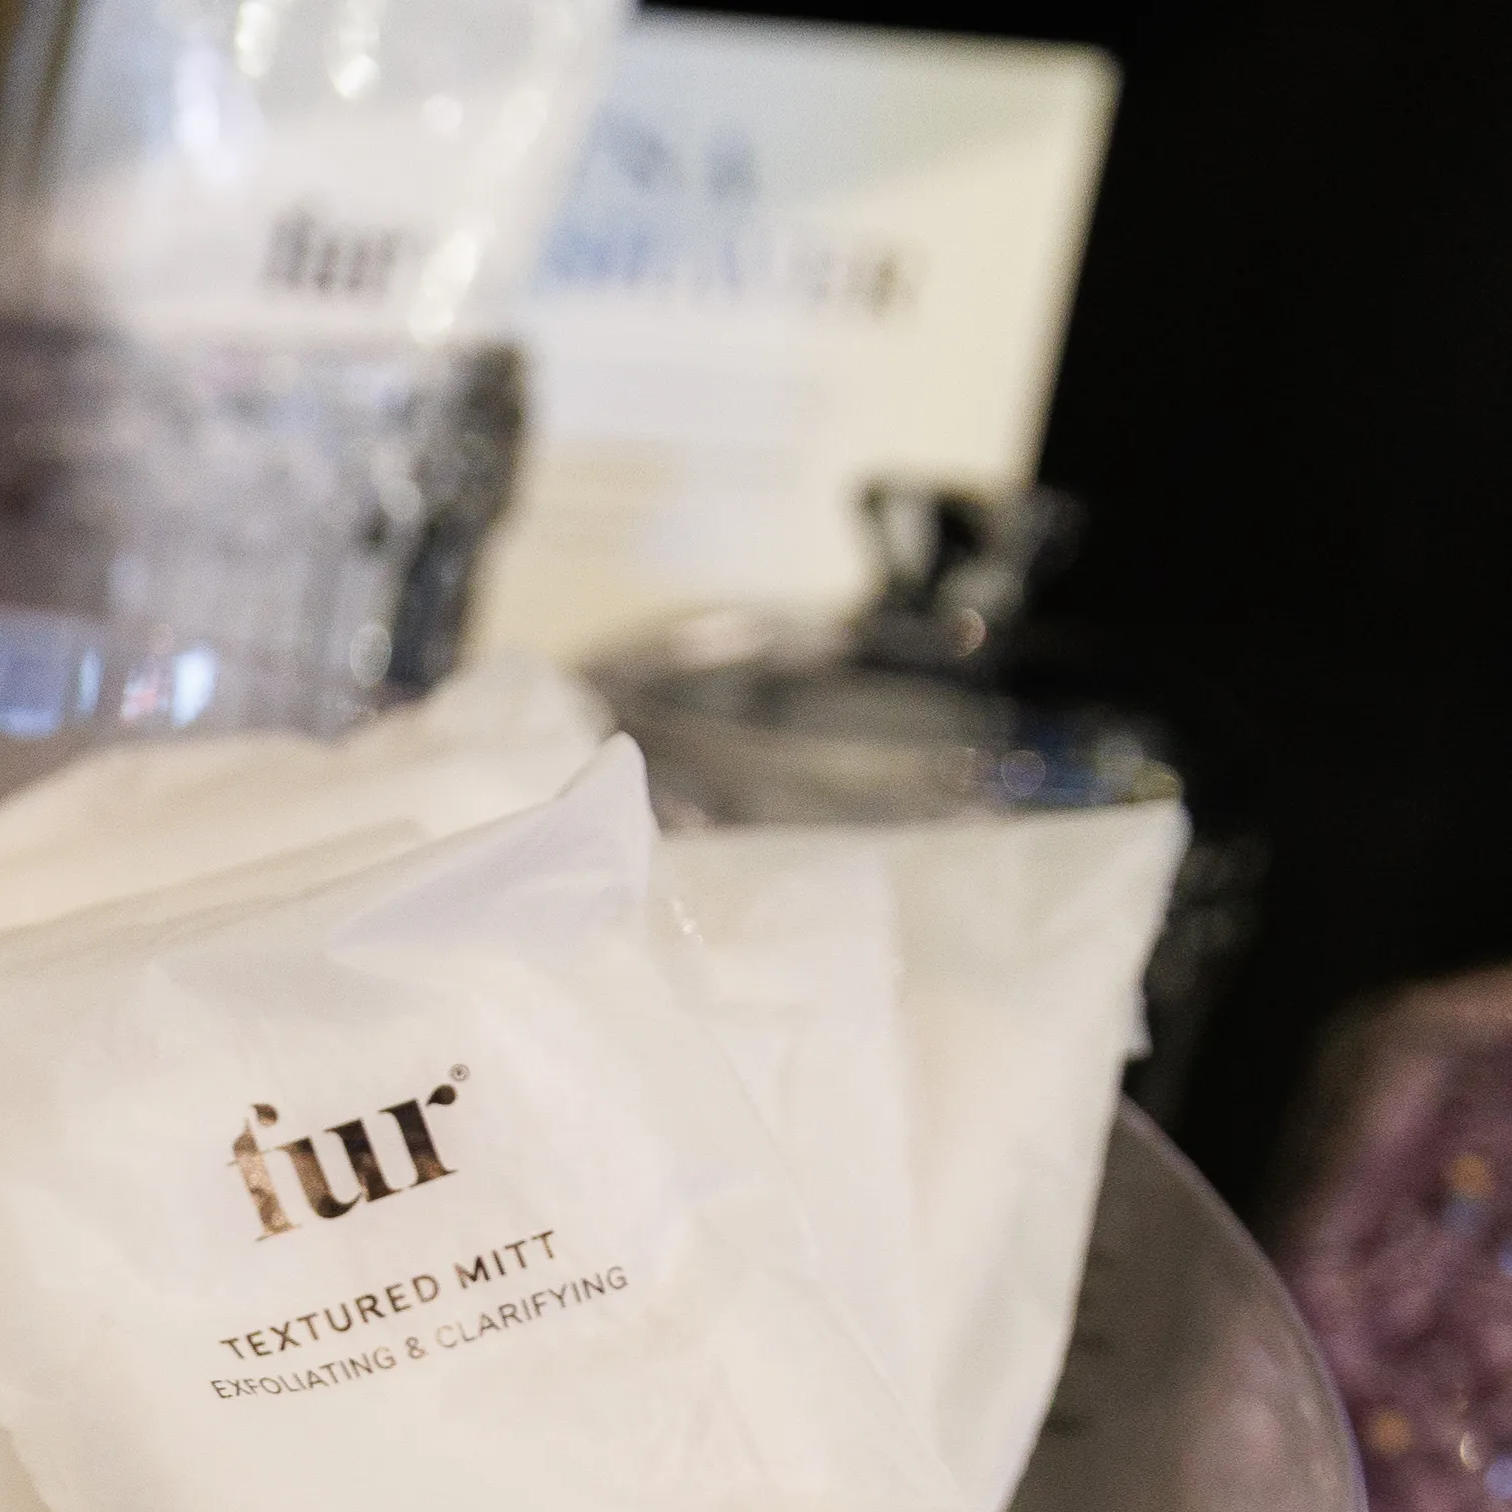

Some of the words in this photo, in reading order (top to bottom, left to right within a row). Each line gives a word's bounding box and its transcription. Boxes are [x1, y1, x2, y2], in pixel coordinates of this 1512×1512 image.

[209, 1345, 398, 1401] EXFOLIATING
[404, 1335, 426, 1360] &
[434, 1265, 630, 1350] CLARIFYING
[218, 1272, 441, 1362] TEXTURED
[452, 1229, 557, 1290] MITT
